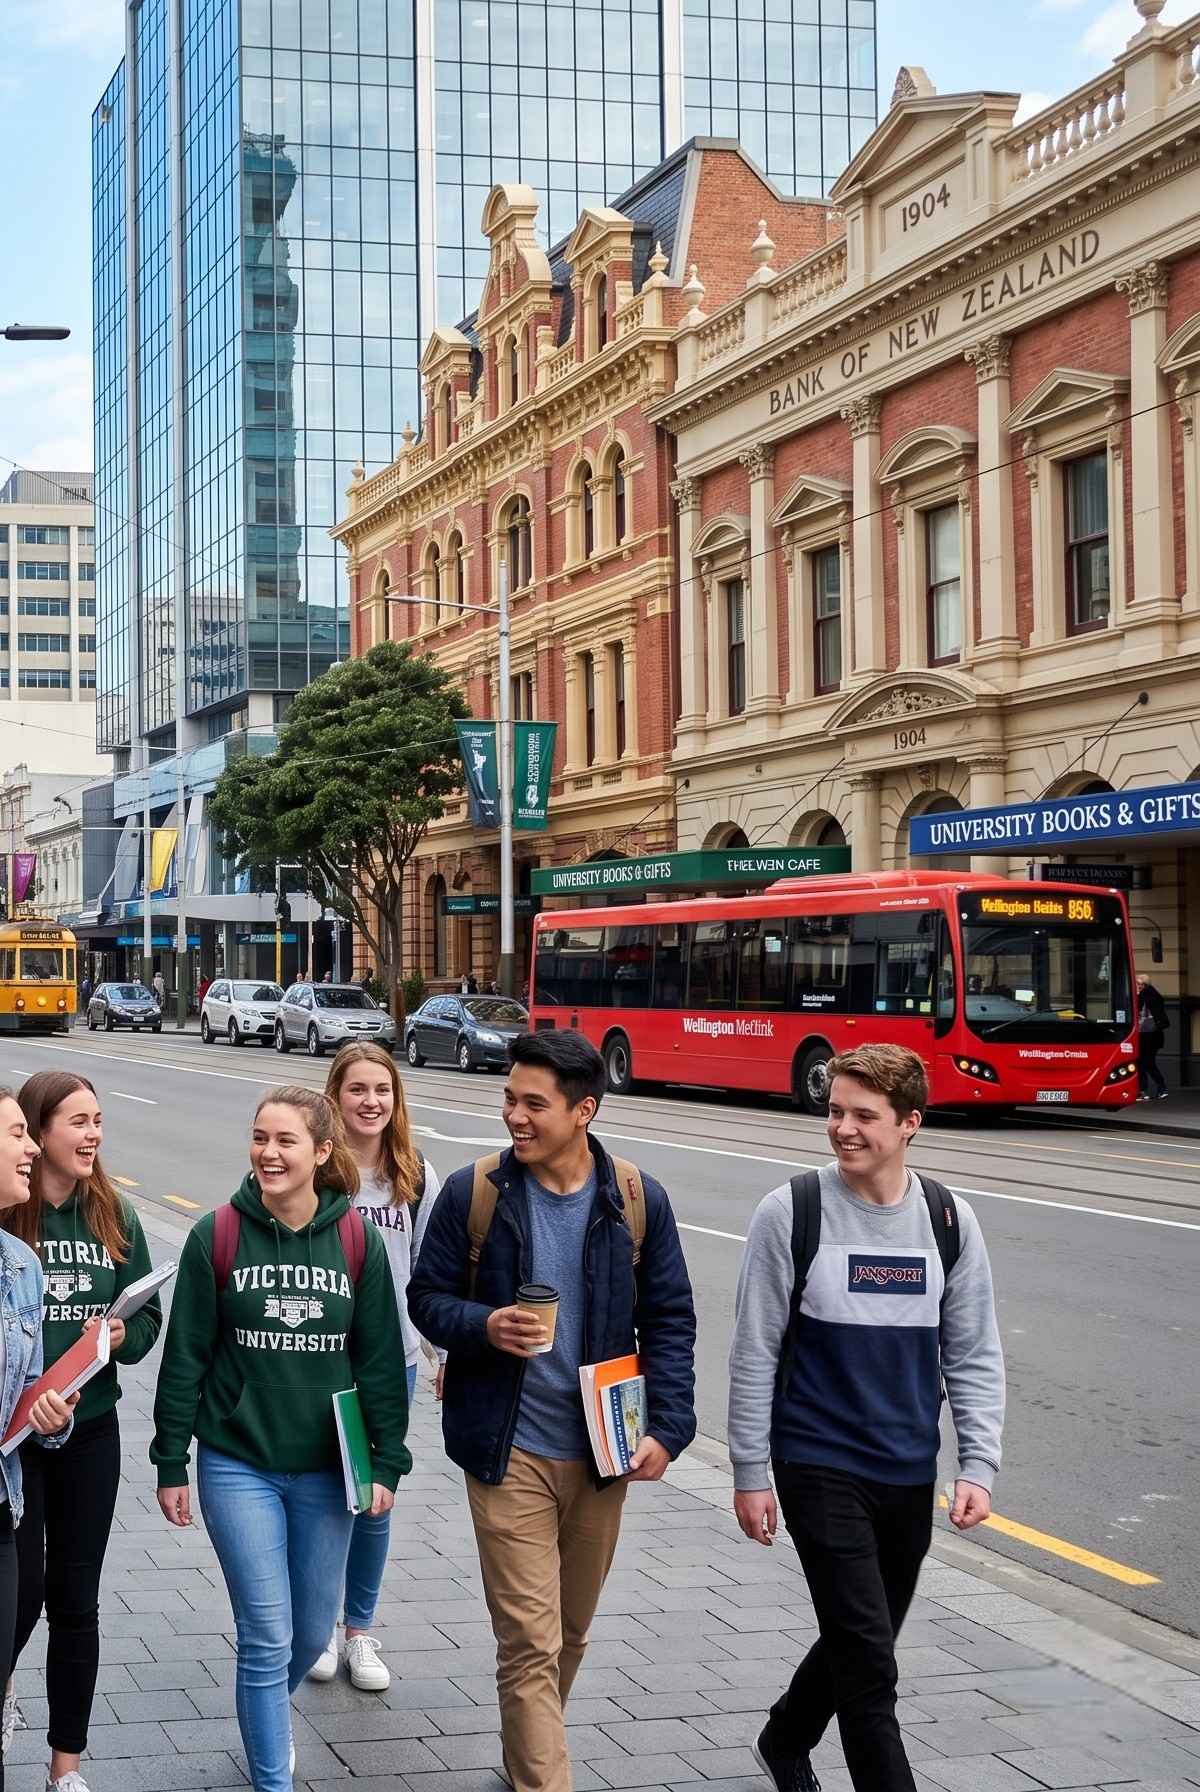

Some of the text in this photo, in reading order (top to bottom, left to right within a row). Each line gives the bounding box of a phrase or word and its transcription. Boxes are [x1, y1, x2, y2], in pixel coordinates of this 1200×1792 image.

[901, 182, 951, 232] 1904
[768, 229, 1100, 416] BANK OF NEW ZEALAND
[894, 727, 927, 750] 1904
[930, 791, 1200, 846] UNIVERSITY BOOKS & GIFTS
[787, 858, 822, 871] CAFE
[552, 869, 601, 888] UNIVERSITY
[682, 1017, 734, 1038] Wellington
[232, 1264, 352, 1299] VICTORIA
[852, 1265, 923, 1285] JANSPORT
[234, 1327, 347, 1352] UNIVERSITY
